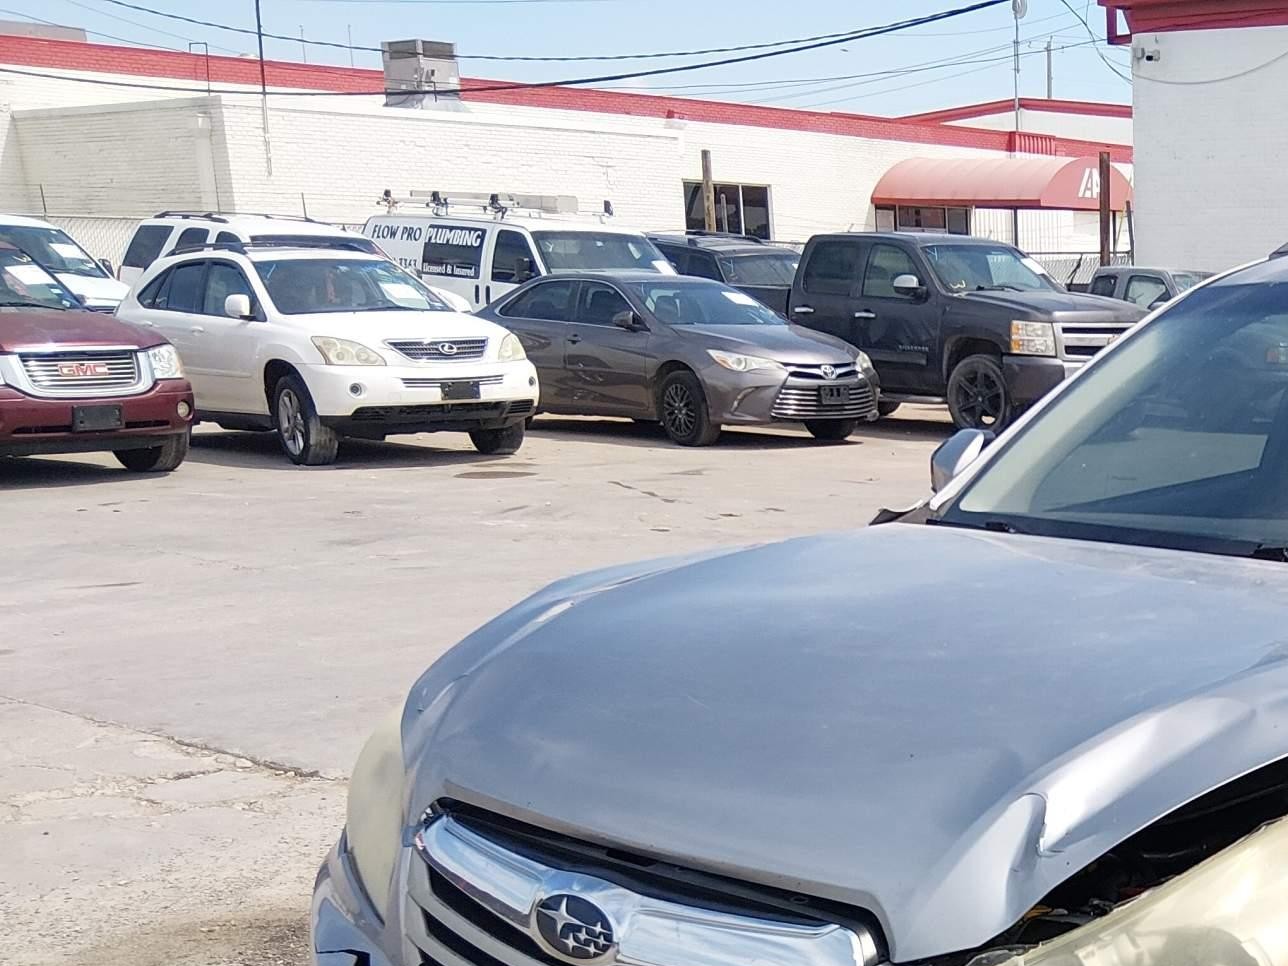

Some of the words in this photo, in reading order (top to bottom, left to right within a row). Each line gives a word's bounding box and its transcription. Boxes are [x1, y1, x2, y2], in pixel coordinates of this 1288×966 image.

[371, 224, 400, 240] FLOW
[401, 226, 422, 241] PRO
[425, 227, 483, 247] PLUMBING
[57, 363, 109, 377] GMC
